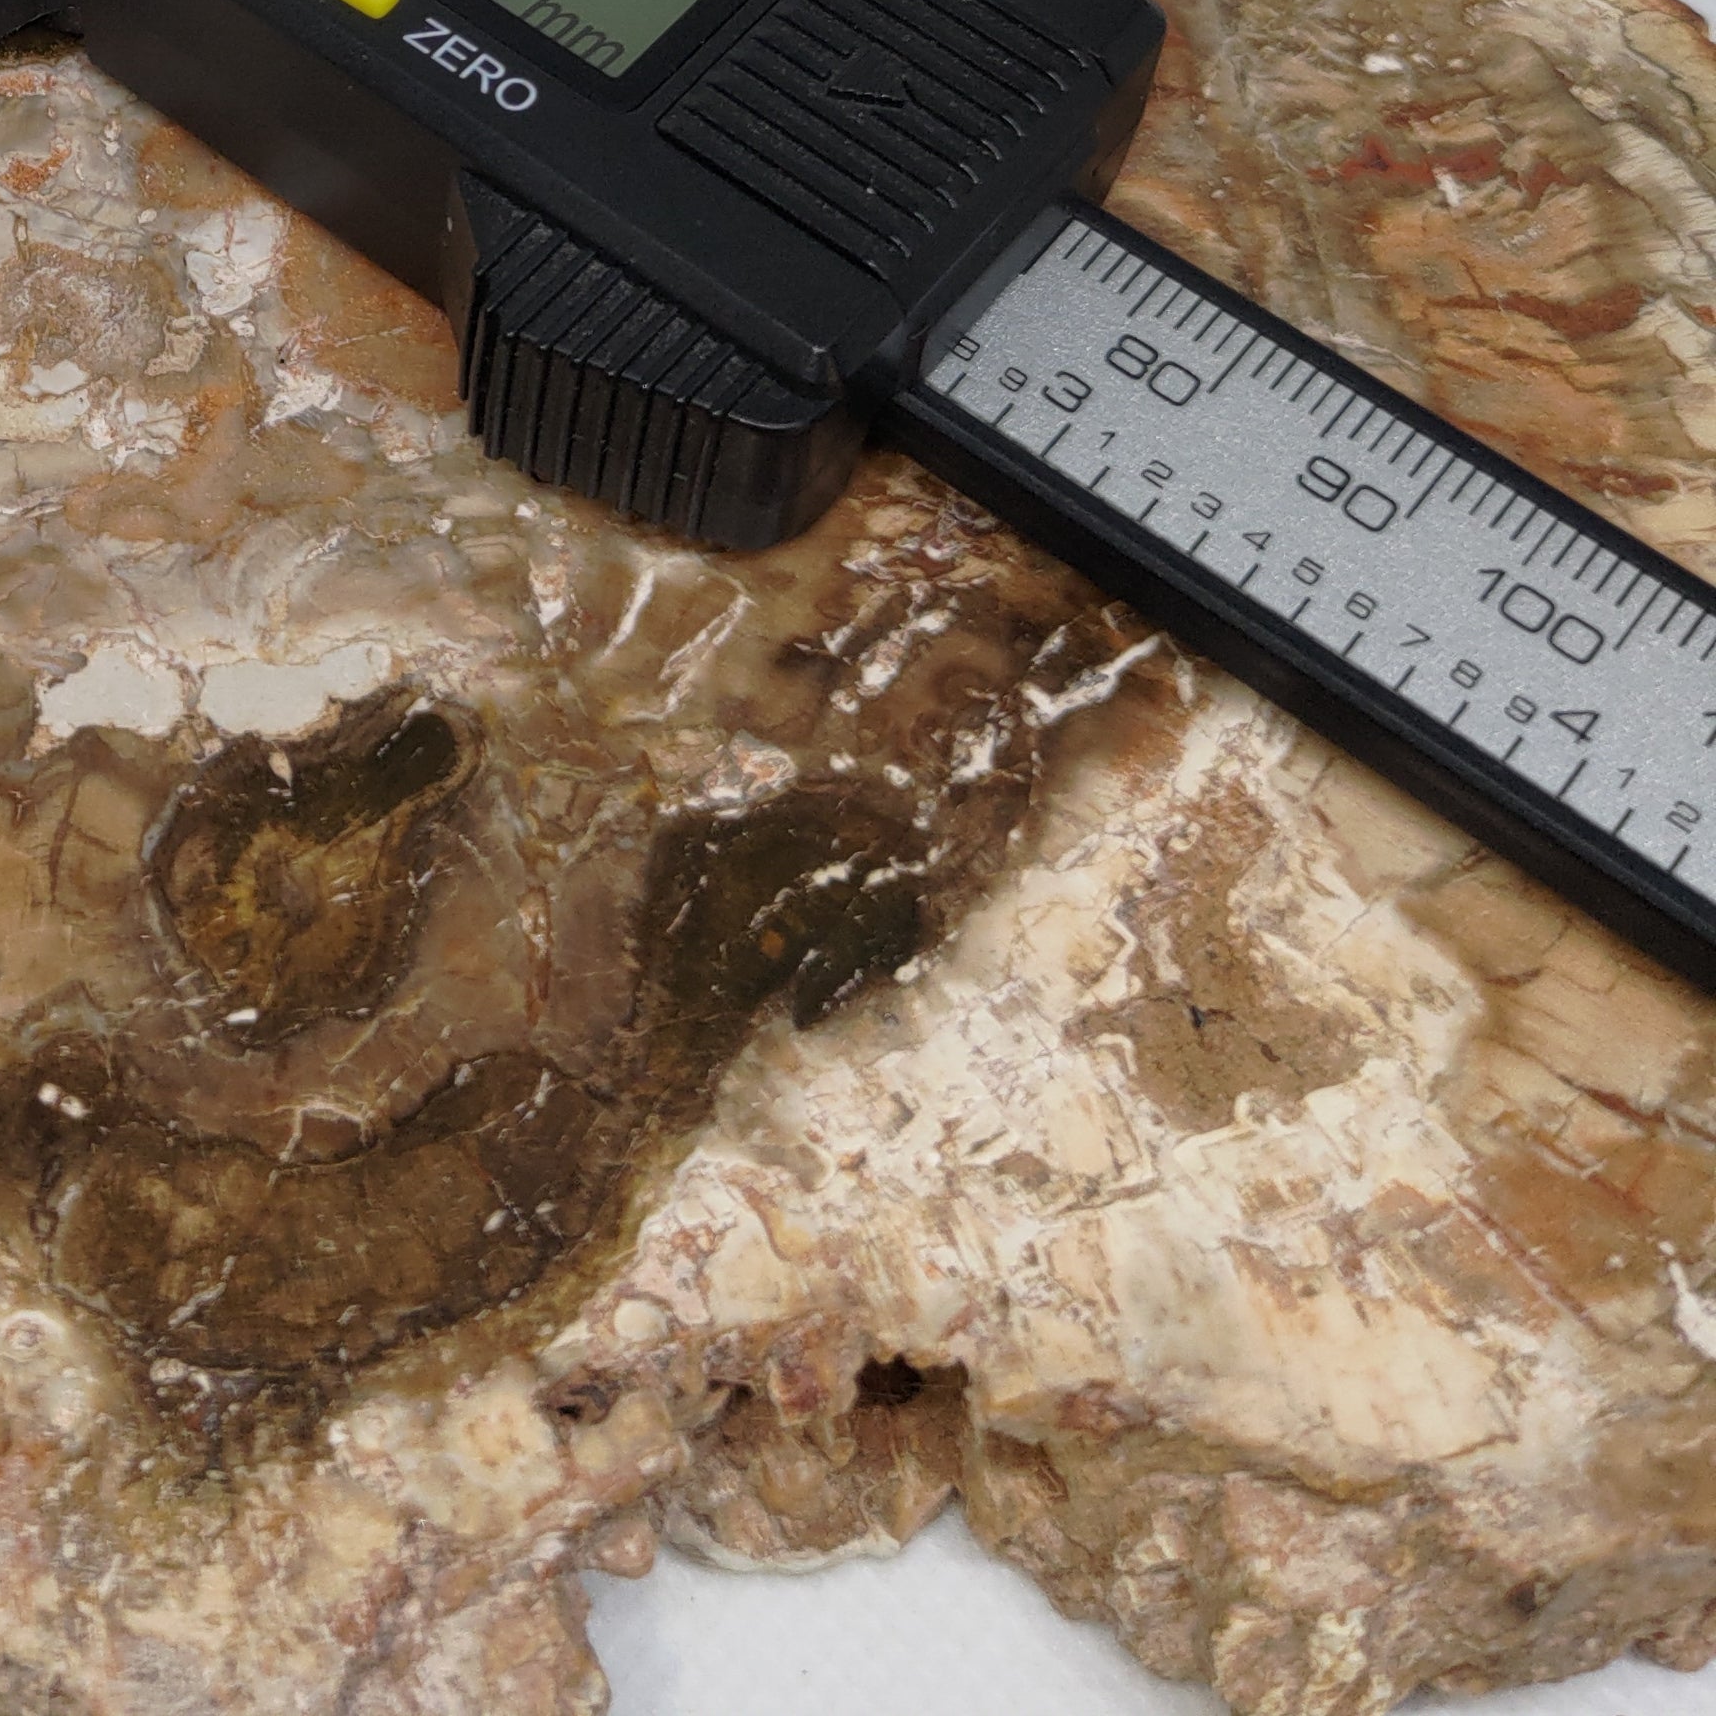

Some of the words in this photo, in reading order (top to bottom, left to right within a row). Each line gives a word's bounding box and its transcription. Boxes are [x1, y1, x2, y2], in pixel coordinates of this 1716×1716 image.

[402, 16, 538, 112] ZERO
[999, 367, 1028, 392] 9
[1041, 370, 1092, 412] 3
[1100, 431, 1116, 450] 1
[1141, 460, 1173, 488] 2
[1191, 491, 1222, 519] 3
[1242, 531, 1272, 551] 4
[1292, 557, 1325, 585] 5
[1345, 591, 1377, 620] 6
[1400, 623, 1432, 647] 7
[1450, 659, 1482, 689] 8
[1504, 695, 1538, 725] 9
[1549, 710, 1600, 743] 4
[1617, 768, 1636, 789] 1
[1666, 800, 1702, 834] 2
[1105, 334, 1201, 406] 80
[1296, 455, 1398, 533] 90
[1480, 568, 1605, 665] 100
